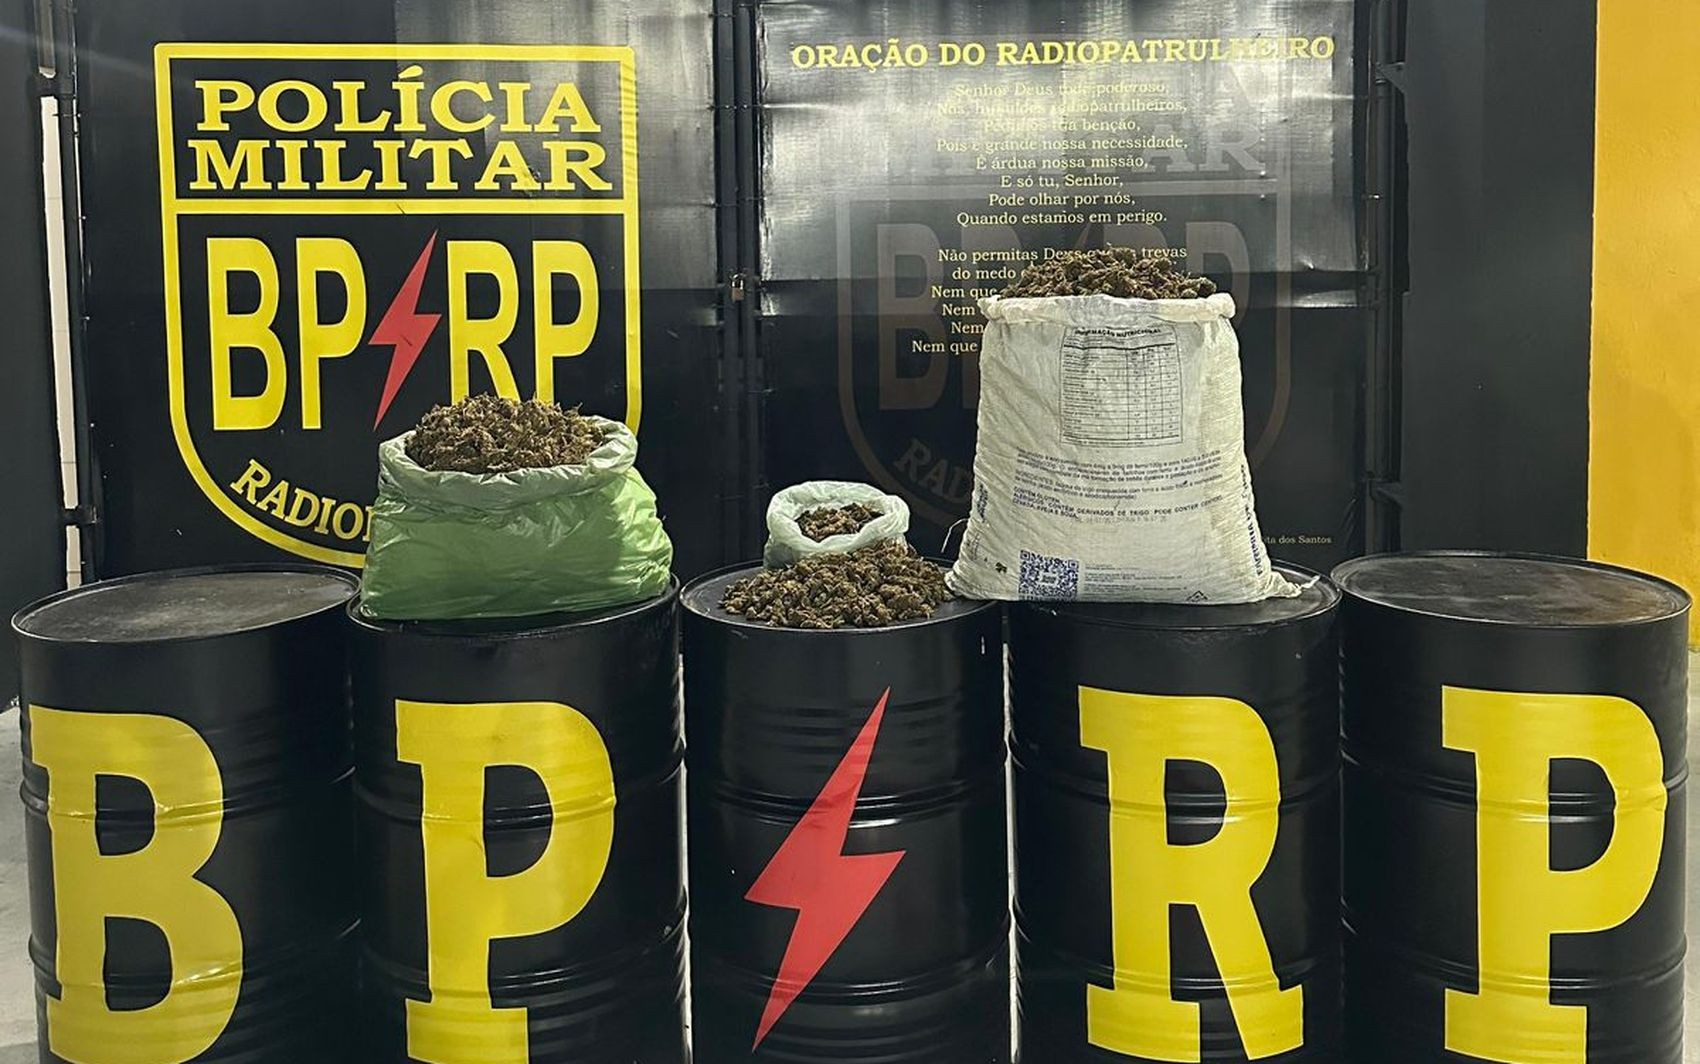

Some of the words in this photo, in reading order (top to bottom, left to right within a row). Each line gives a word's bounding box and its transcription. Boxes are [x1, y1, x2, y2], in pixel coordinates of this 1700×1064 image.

[791, 38, 929, 73] ORAÇÃO
[938, 42, 986, 66] DO
[996, 35, 1335, 66] RADIOPATRULHEIRO
[1014, 82, 1053, 95] Deus
[195, 65, 602, 132] POLÍCIA
[1083, 117, 1140, 133] benção,
[937, 139, 967, 152] Pois
[985, 138, 1039, 154] grande
[1043, 139, 1086, 150] nossa
[1091, 135, 1188, 151] necessidade,
[188, 138, 613, 191] MILITAR
[976, 154, 987, 169] É
[991, 154, 1037, 168] árdua
[1042, 157, 1086, 168] nossa
[1091, 154, 1149, 169] missão,
[1001, 175, 1012, 188] E
[1017, 175, 1034, 188] só
[1038, 176, 1060, 189] tu,
[1064, 173, 1124, 189] Senhor,
[988, 193, 1024, 207] Pode
[1029, 192, 1070, 206] olhar
[1074, 195, 1100, 209] por
[1103, 192, 1136, 207] nós,
[957, 211, 1018, 227] Quando
[1022, 212, 1084, 224] estamos
[1089, 213, 1112, 223] em
[1116, 210, 1168, 226] perigo.
[938, 248, 968, 262] Não
[972, 247, 1039, 264] permitas
[1142, 246, 1187, 259] trevas
[952, 267, 971, 280] do
[976, 266, 1016, 280] medo
[931, 285, 965, 298] Nem
[969, 288, 998, 300] que
[942, 303, 976, 316] Nem
[951, 322, 985, 334] Nem
[912, 340, 945, 353] Nem
[949, 342, 979, 355] que
[1278, 535, 1296, 544] dos
[1299, 534, 1333, 544] Santos
[395, 698, 617, 1064] P
[1077, 685, 1304, 1064] R
[1441, 685, 1667, 1064] P
[28, 703, 244, 1064] B
